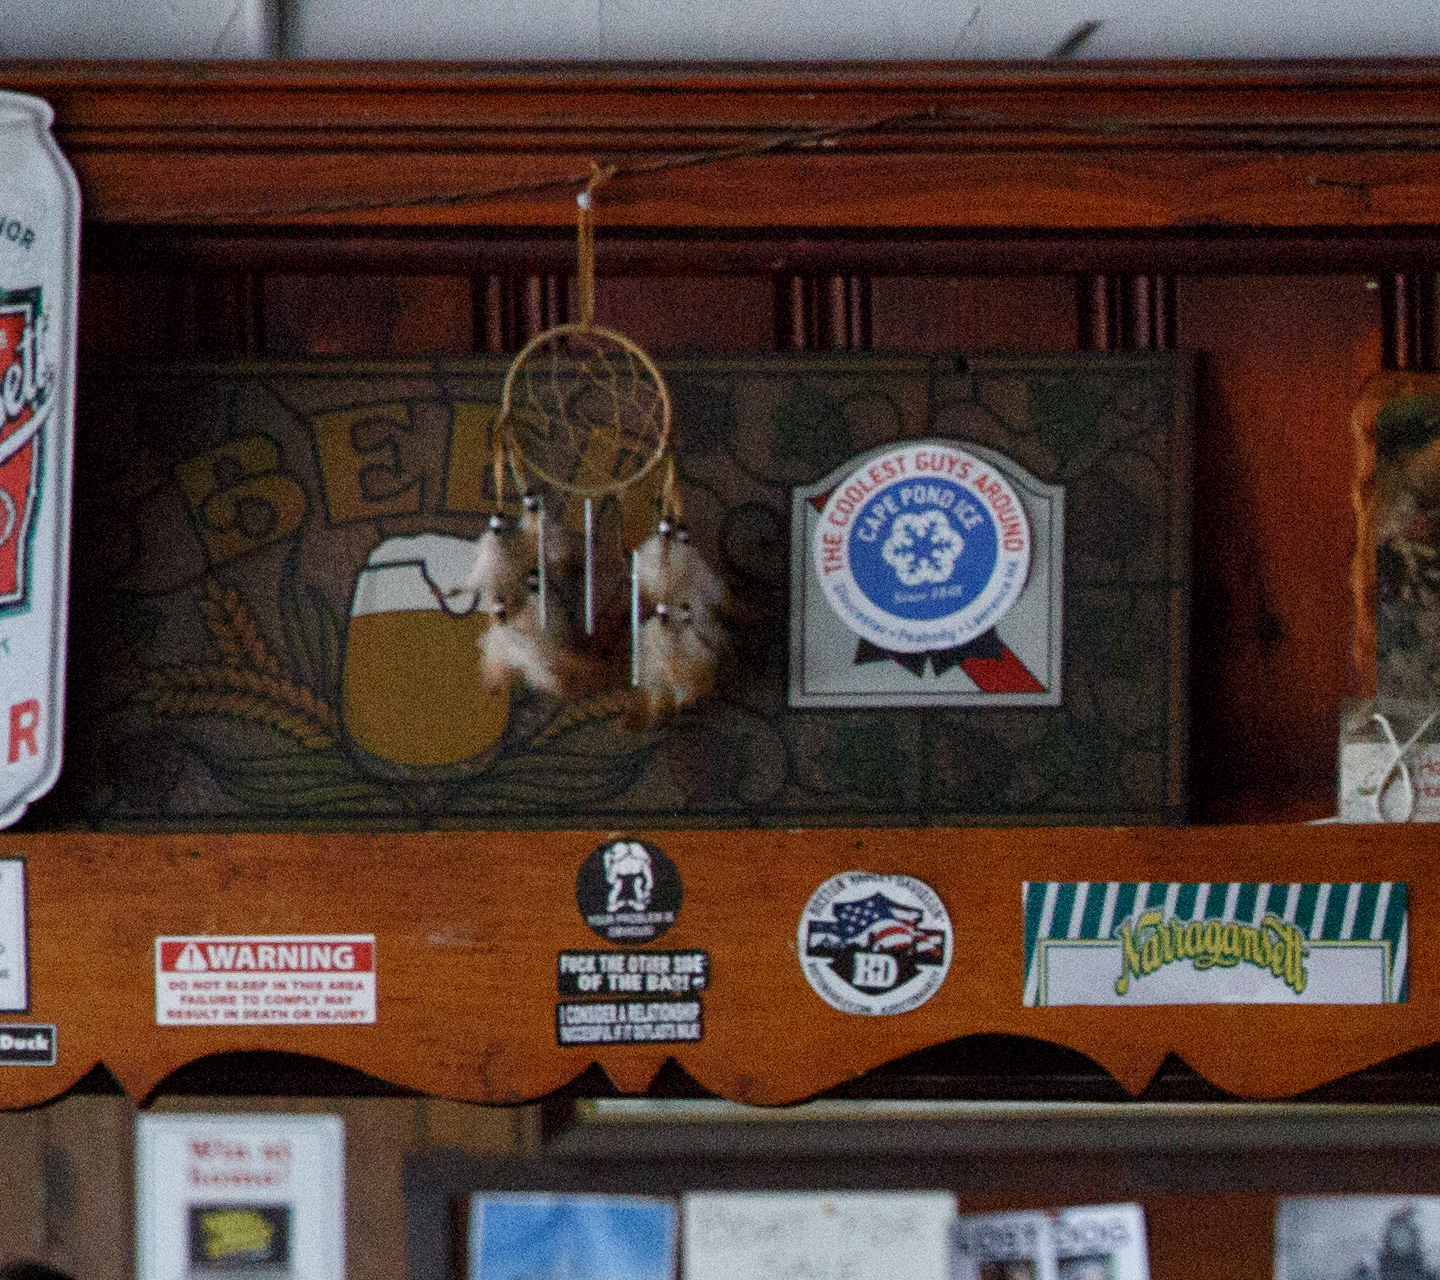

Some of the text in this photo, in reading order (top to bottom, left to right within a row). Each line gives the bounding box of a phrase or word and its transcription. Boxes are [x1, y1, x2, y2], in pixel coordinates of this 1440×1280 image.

[822, 452, 1025, 576] THE COOLEST GUYS AROUND
[857, 485, 985, 543] CAPE POND ICE
[205, 944, 357, 971] WARNING
[1114, 907, 1310, 997] Narragansett
[192, 980, 221, 991] NOT
[226, 980, 268, 991] SLEEP
[272, 980, 287, 991] IN
[291, 980, 323, 991] THIS
[328, 980, 365, 991] AREA
